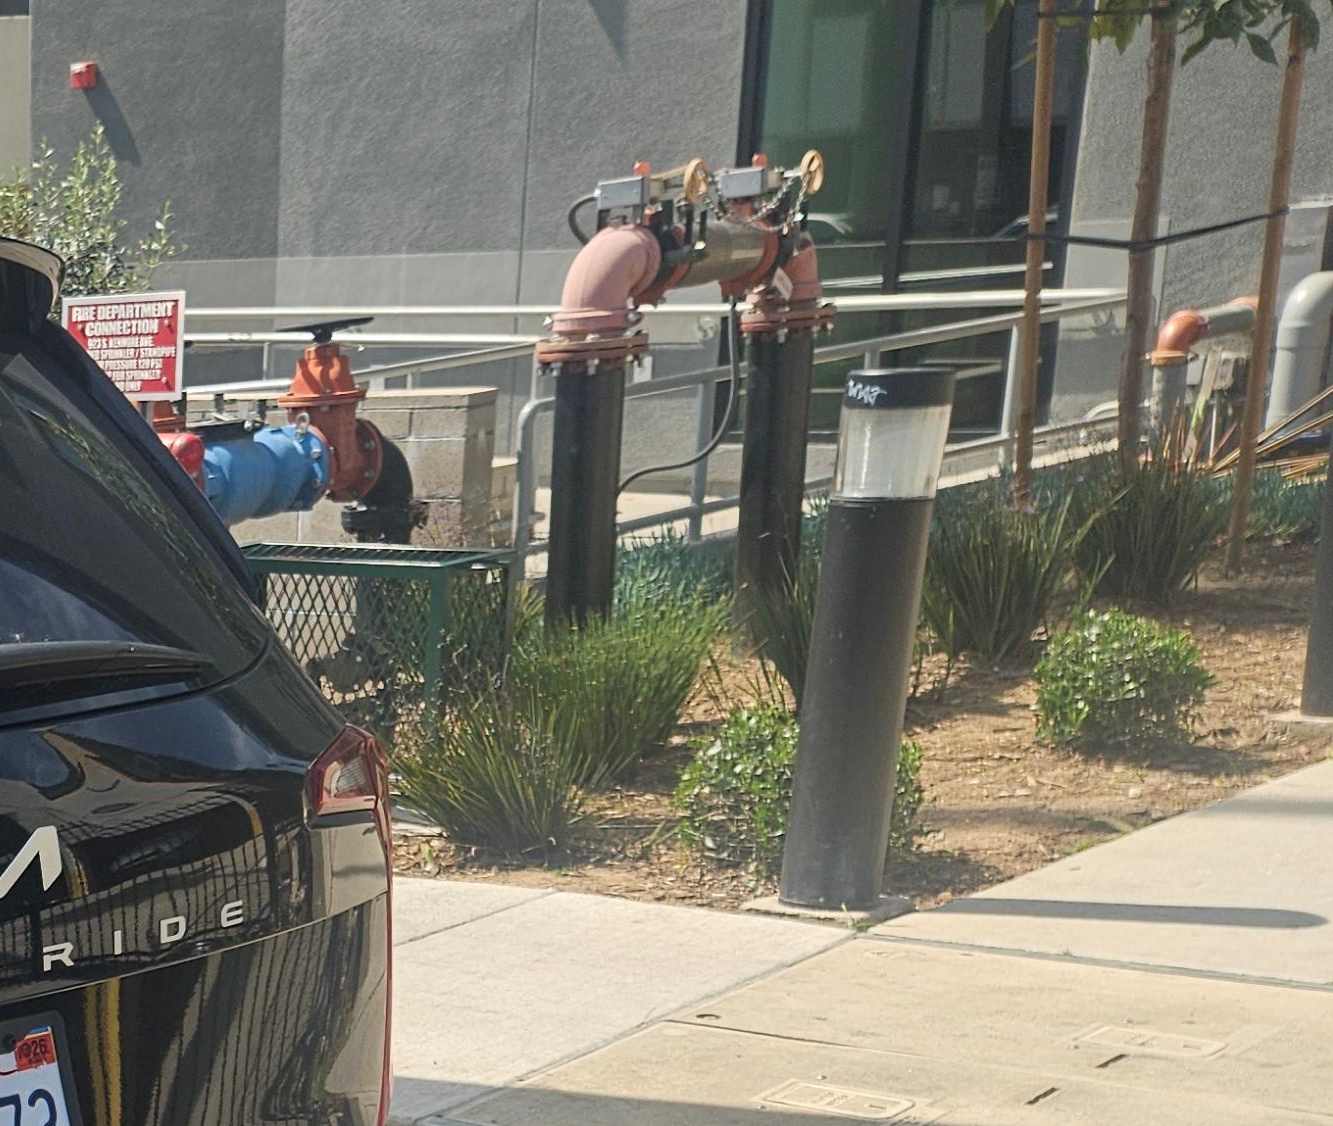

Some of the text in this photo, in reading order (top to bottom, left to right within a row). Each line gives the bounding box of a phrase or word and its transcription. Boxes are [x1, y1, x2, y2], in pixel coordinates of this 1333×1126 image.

[71, 302, 174, 322] FIRE DEPARTMENT
[85, 319, 159, 336] CONNECTION
[101, 348, 134, 360] SPRINKLER
[140, 347, 176, 359] STANDPIPE
[106, 360, 138, 371] PRESSURE
[126, 381, 142, 392] ONLY
